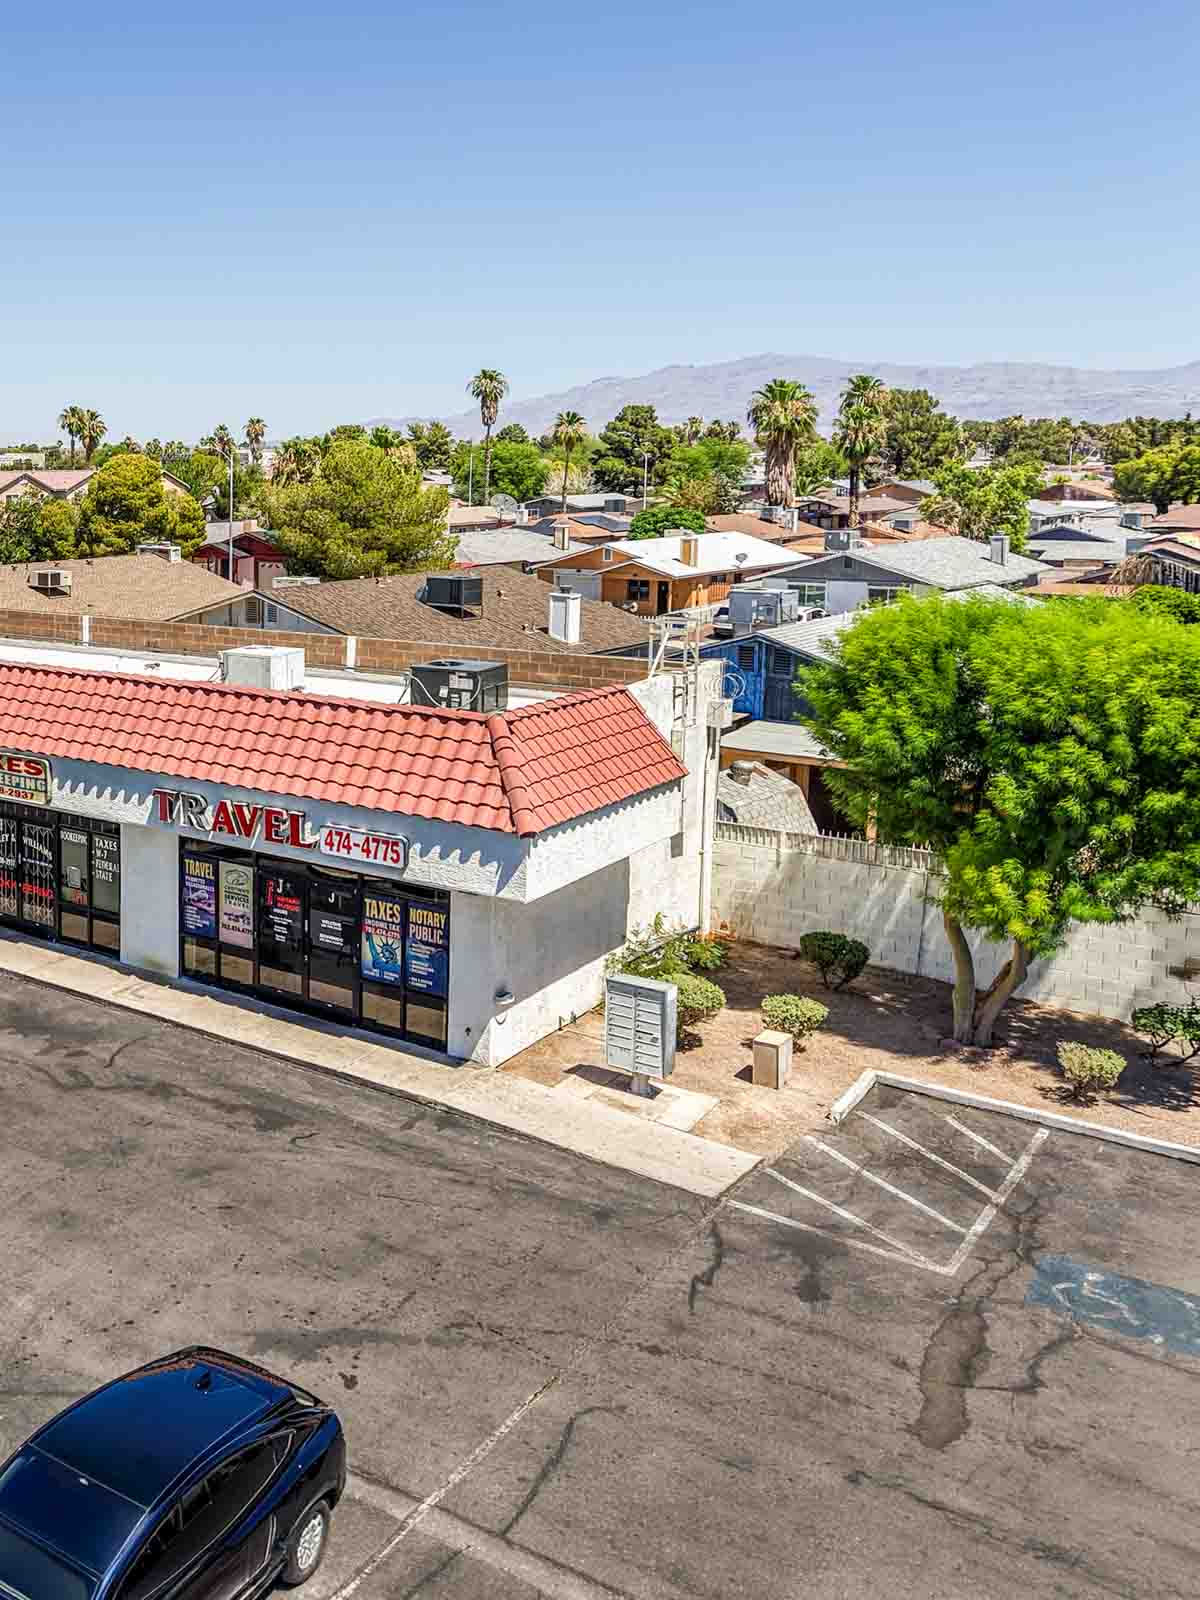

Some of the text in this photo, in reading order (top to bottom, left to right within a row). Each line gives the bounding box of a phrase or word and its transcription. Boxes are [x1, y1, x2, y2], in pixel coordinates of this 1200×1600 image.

[152, 788, 320, 850] TRAVEL
[95, 838, 118, 851] TAXES
[324, 829, 402, 865] 474-4775
[184, 859, 215, 880] TRAVEL
[364, 898, 400, 923] TAXES
[409, 907, 447, 929] NOTARY
[409, 923, 443, 945] PUBLIC
